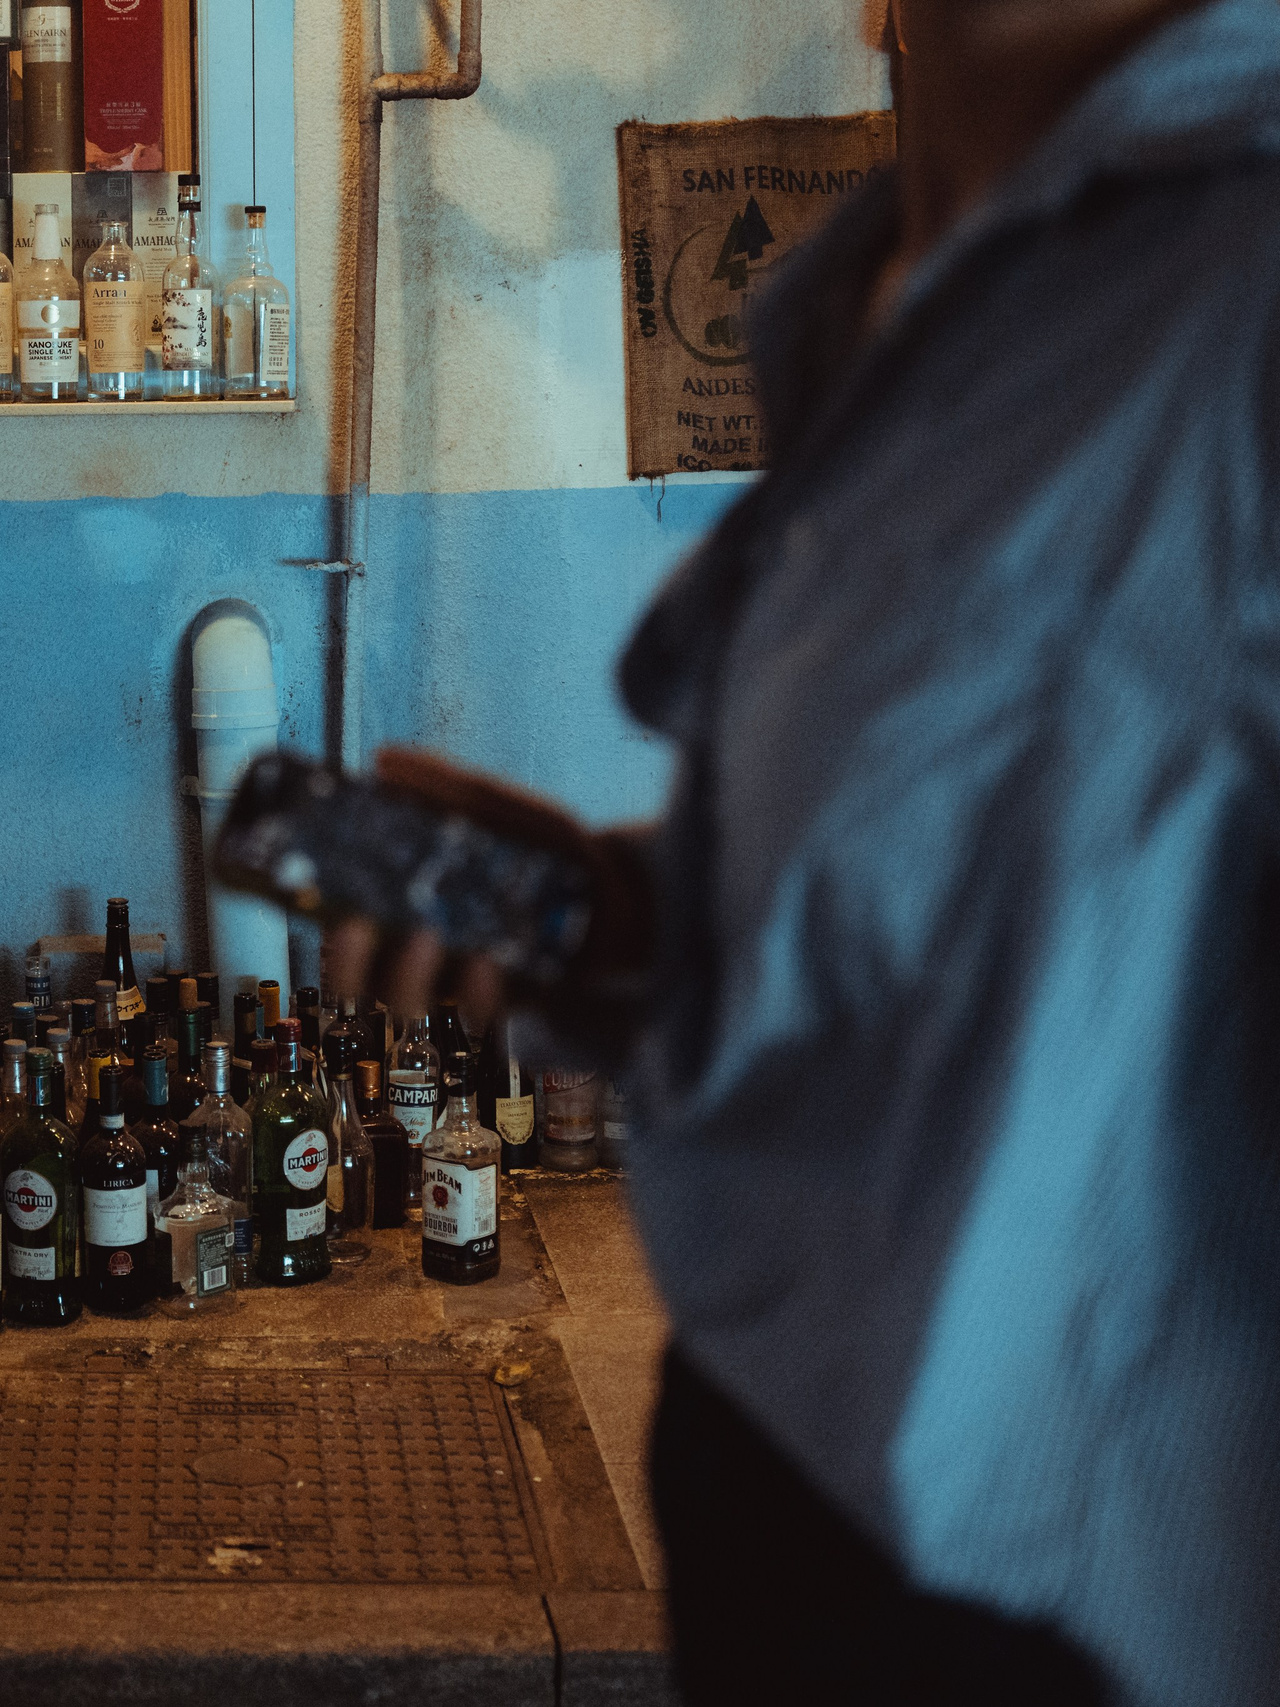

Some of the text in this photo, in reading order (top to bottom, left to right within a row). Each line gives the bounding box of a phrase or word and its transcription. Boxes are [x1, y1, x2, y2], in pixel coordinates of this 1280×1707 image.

[682, 165, 870, 195] SAN FERNAND
[93, 287, 127, 299] Arran
[638, 307, 658, 339] ON
[94, 339, 105, 350] 10
[682, 377, 757, 397] ANDES
[677, 410, 716, 432] NET
[691, 435, 751, 455] MADE
[388, 1086, 439, 1105] CAMPARI
[289, 1149, 327, 1169] MARTINI
[103, 1178, 135, 1188] LIRICA
[422, 1168, 463, 1195] JIM BEAM
[5, 1192, 53, 1207] MARTINI
[298, 1208, 321, 1218] ROSSO
[423, 1216, 458, 1236] BOURBON
[11, 1248, 49, 1259] EXTRA DRY
